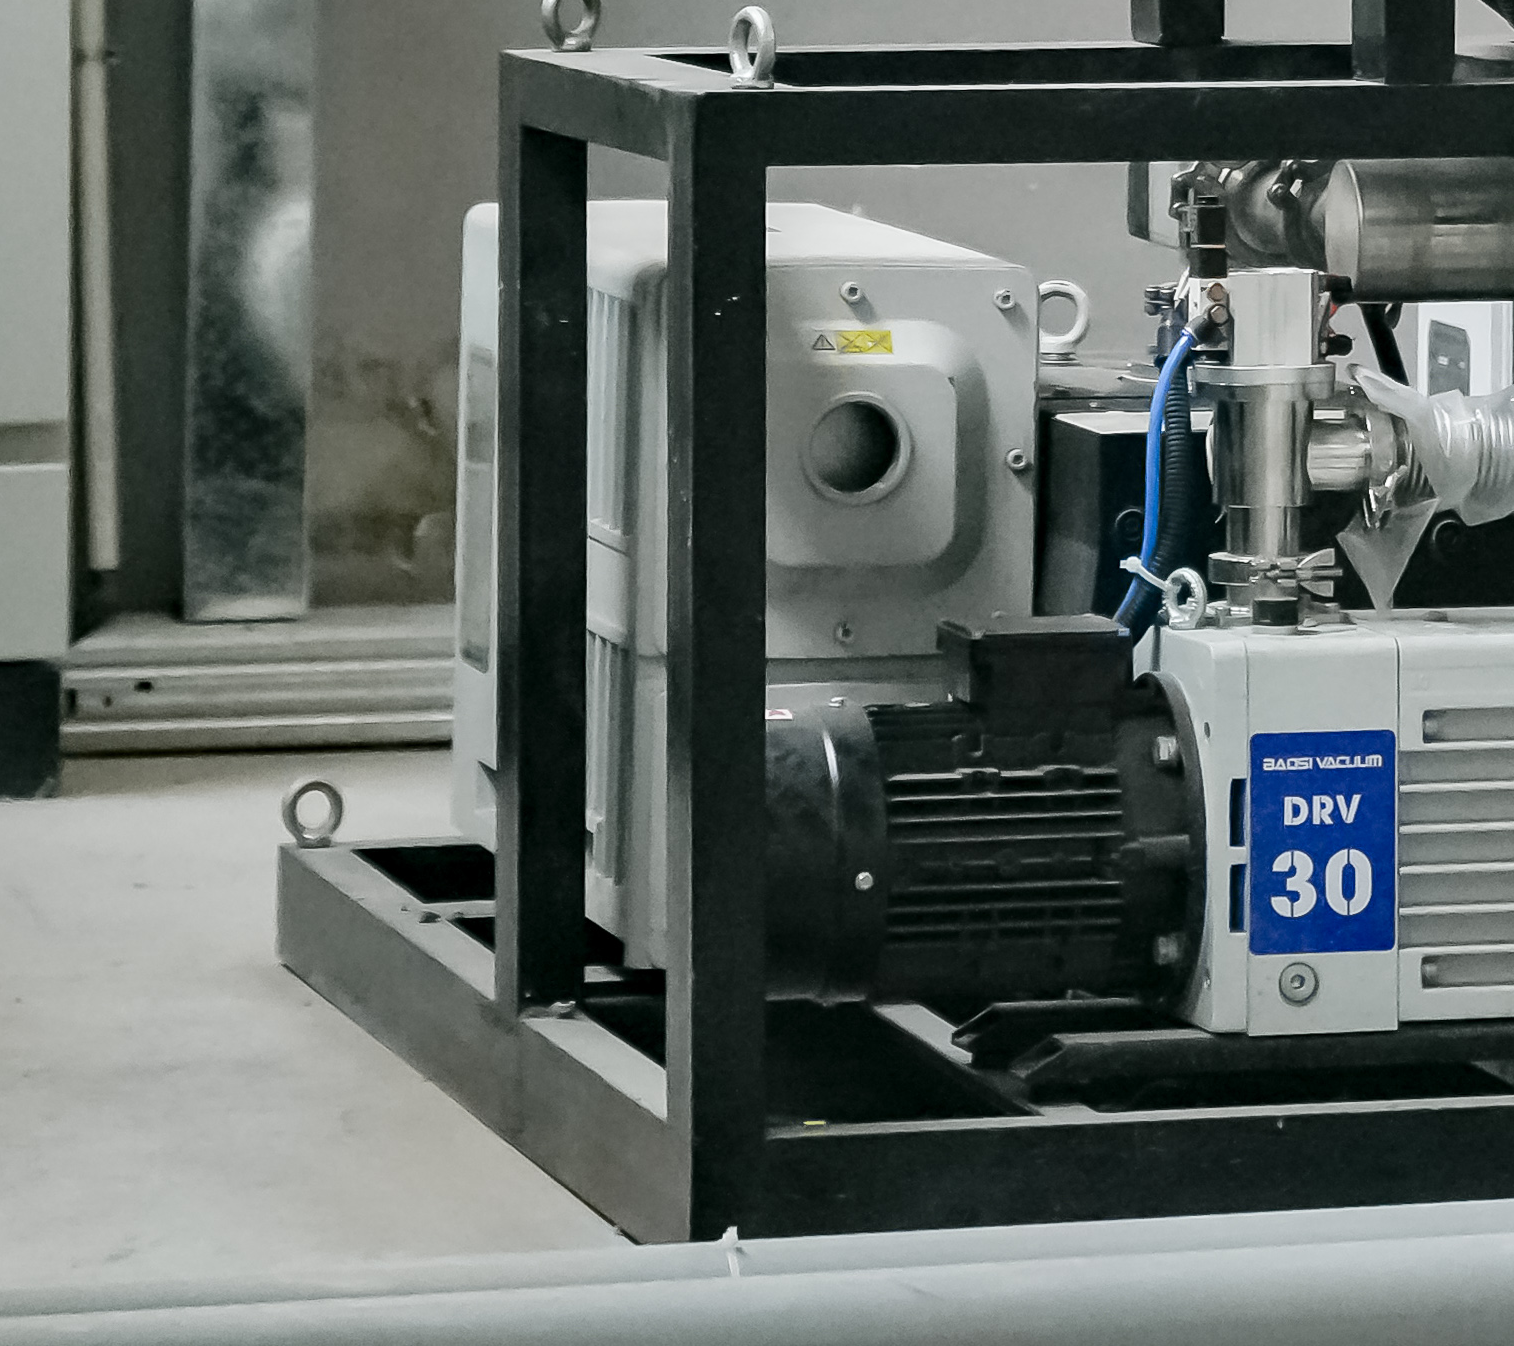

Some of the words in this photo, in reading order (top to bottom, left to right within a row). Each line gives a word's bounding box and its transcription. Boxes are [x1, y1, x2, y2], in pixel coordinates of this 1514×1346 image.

[1263, 757, 1313, 771] BAOSI
[1316, 754, 1382, 769] VACUUM
[1283, 793, 1362, 826] DRV
[1270, 848, 1372, 918] 30
